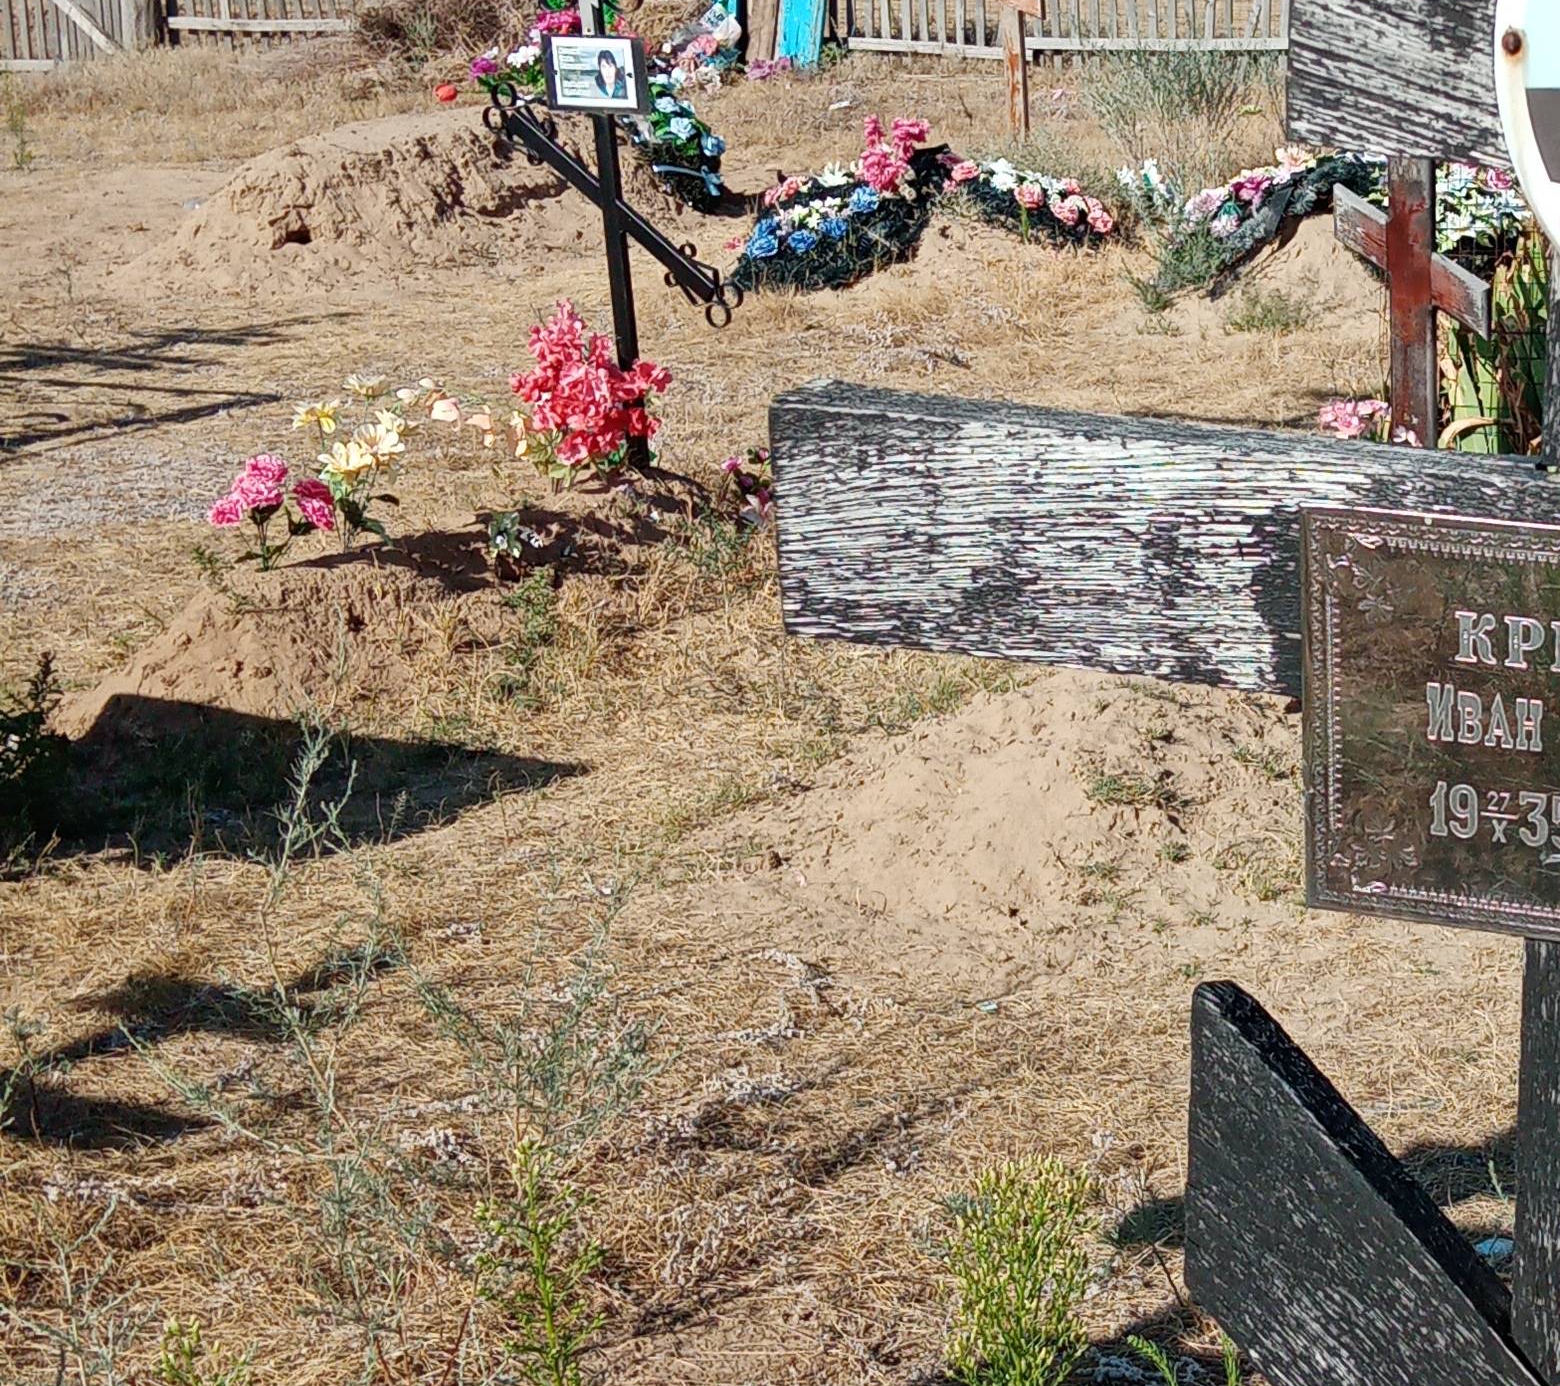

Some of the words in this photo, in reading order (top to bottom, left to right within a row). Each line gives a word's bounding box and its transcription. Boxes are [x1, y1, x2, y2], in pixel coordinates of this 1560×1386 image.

[1425, 681, 1543, 753] ИВАН
[1430, 780, 1478, 839] 19
[1487, 790, 1512, 812] 27
